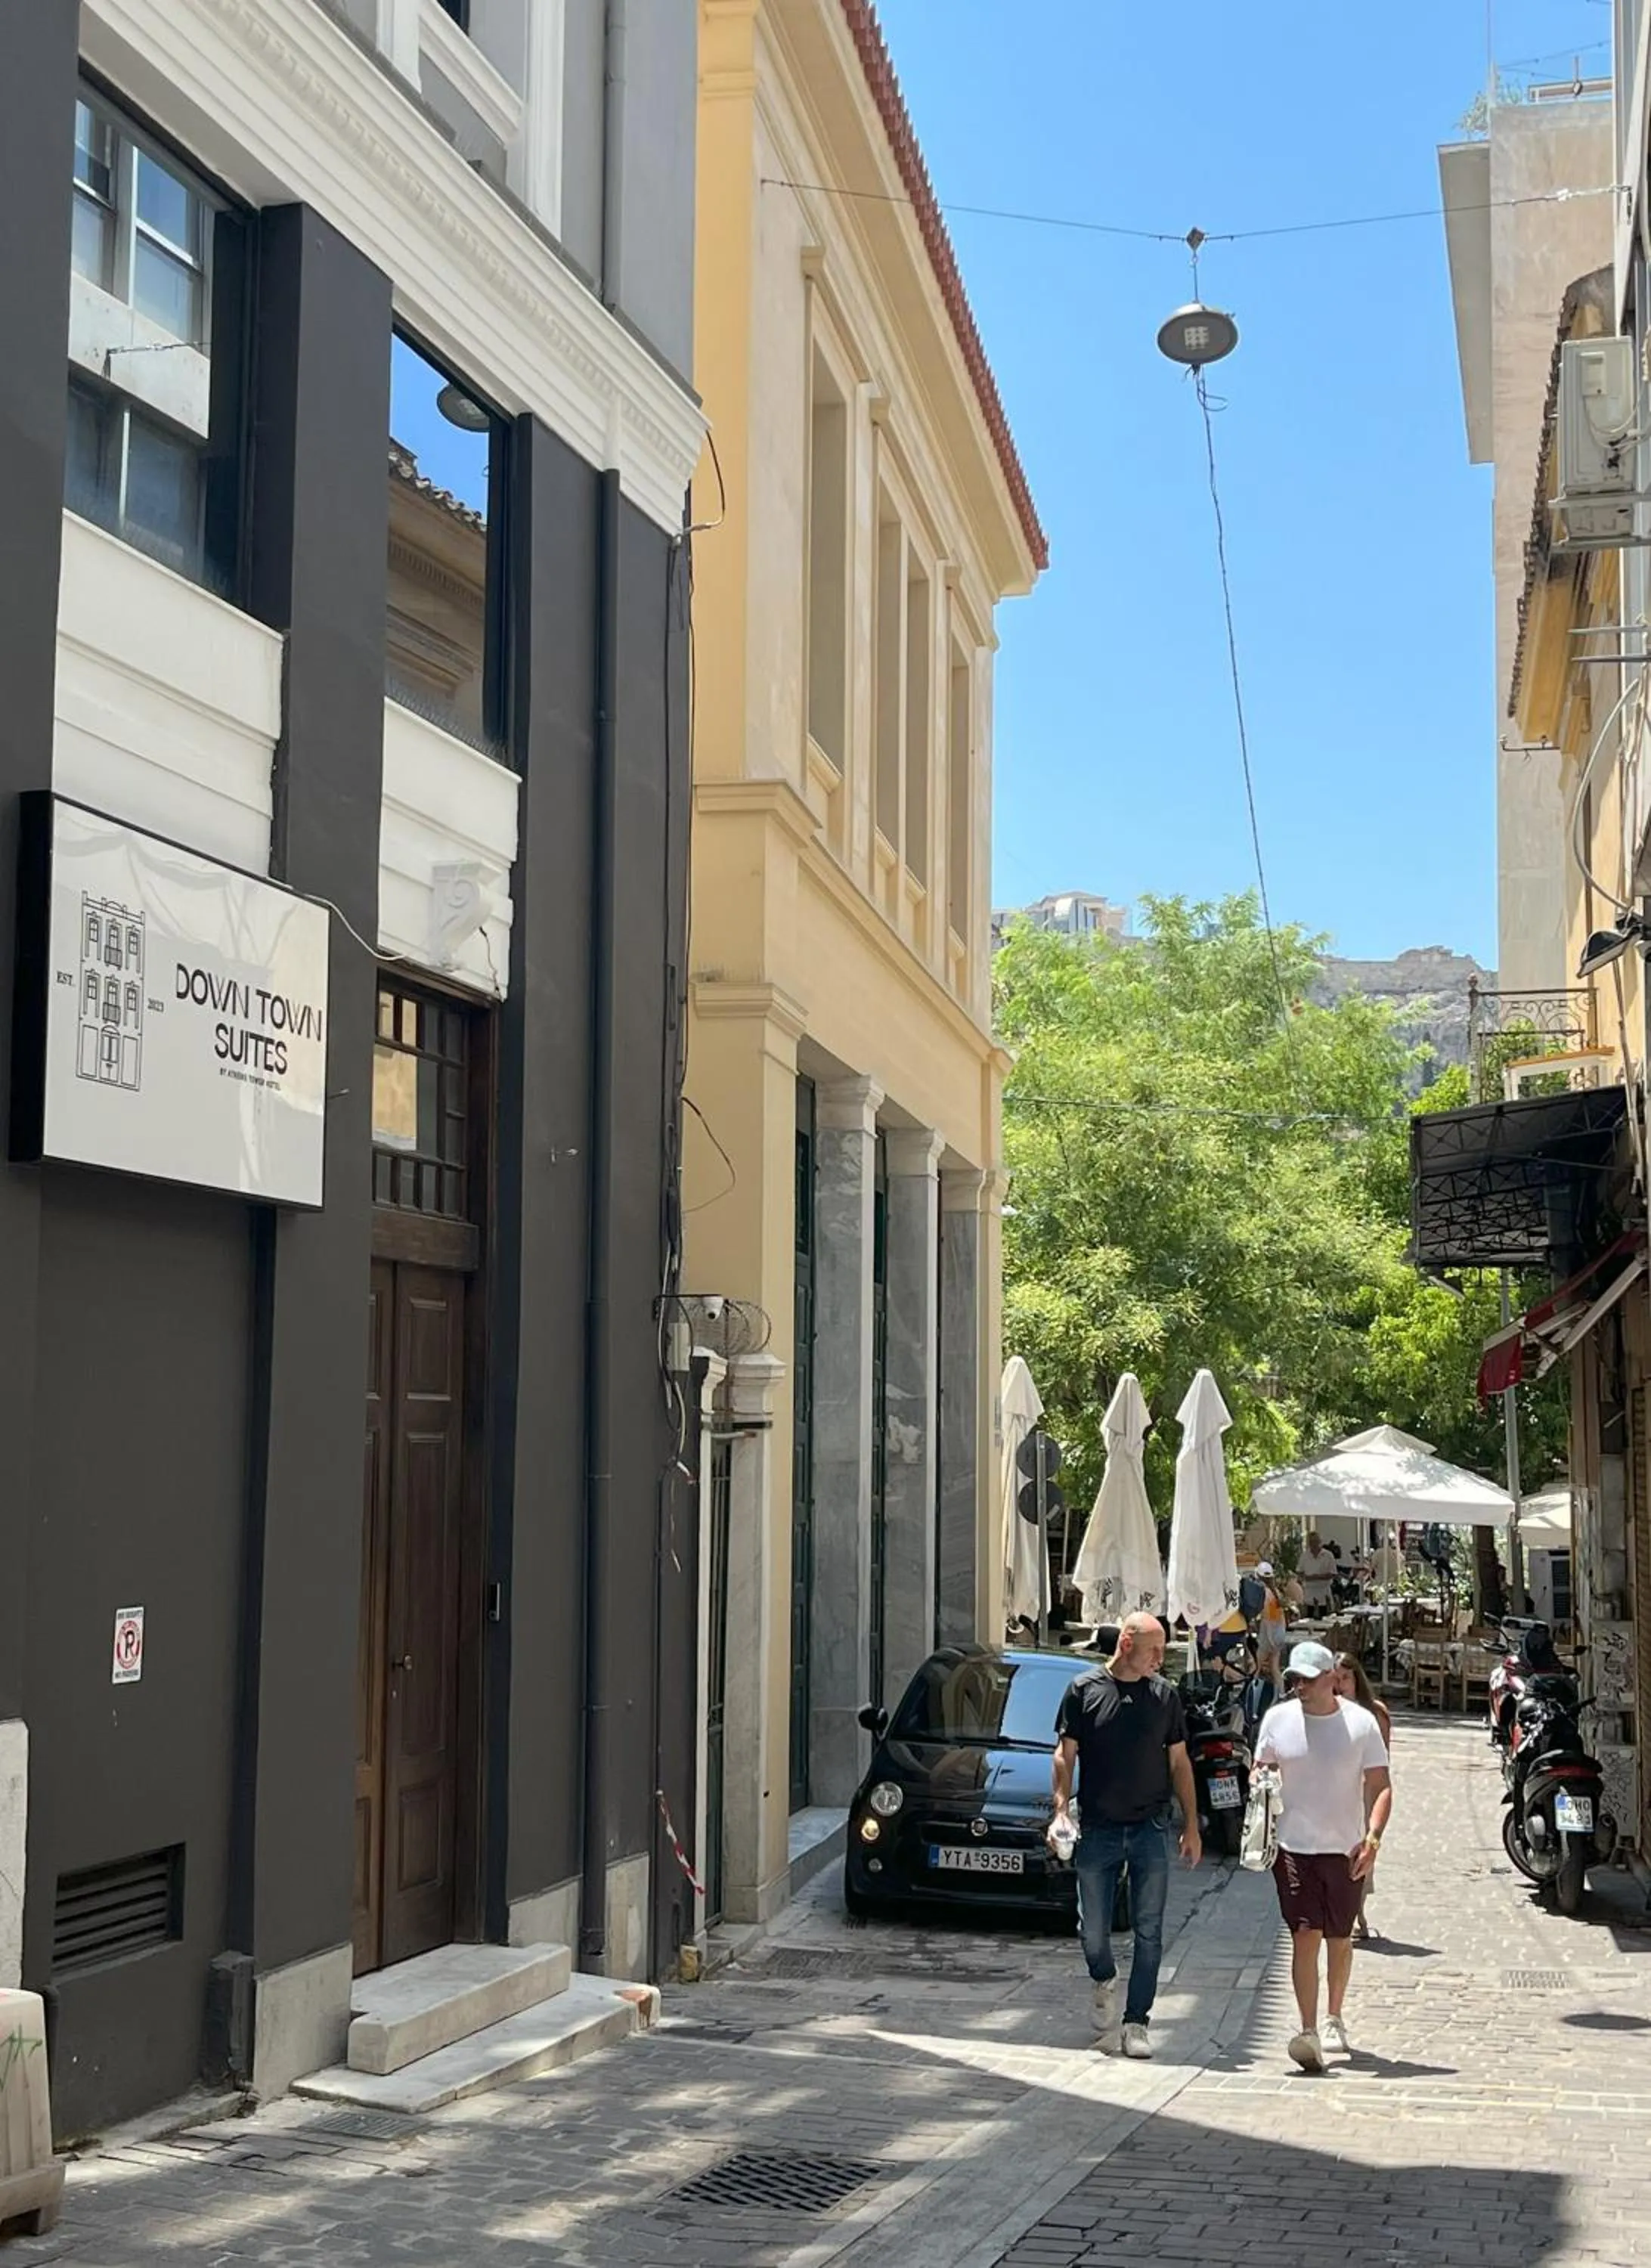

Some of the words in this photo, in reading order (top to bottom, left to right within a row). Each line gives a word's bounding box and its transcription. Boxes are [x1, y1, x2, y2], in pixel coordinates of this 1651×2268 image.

[176, 962, 249, 1019] DOWN
[256, 989, 322, 1042] TOWN
[214, 1023, 288, 1075] SUITES
